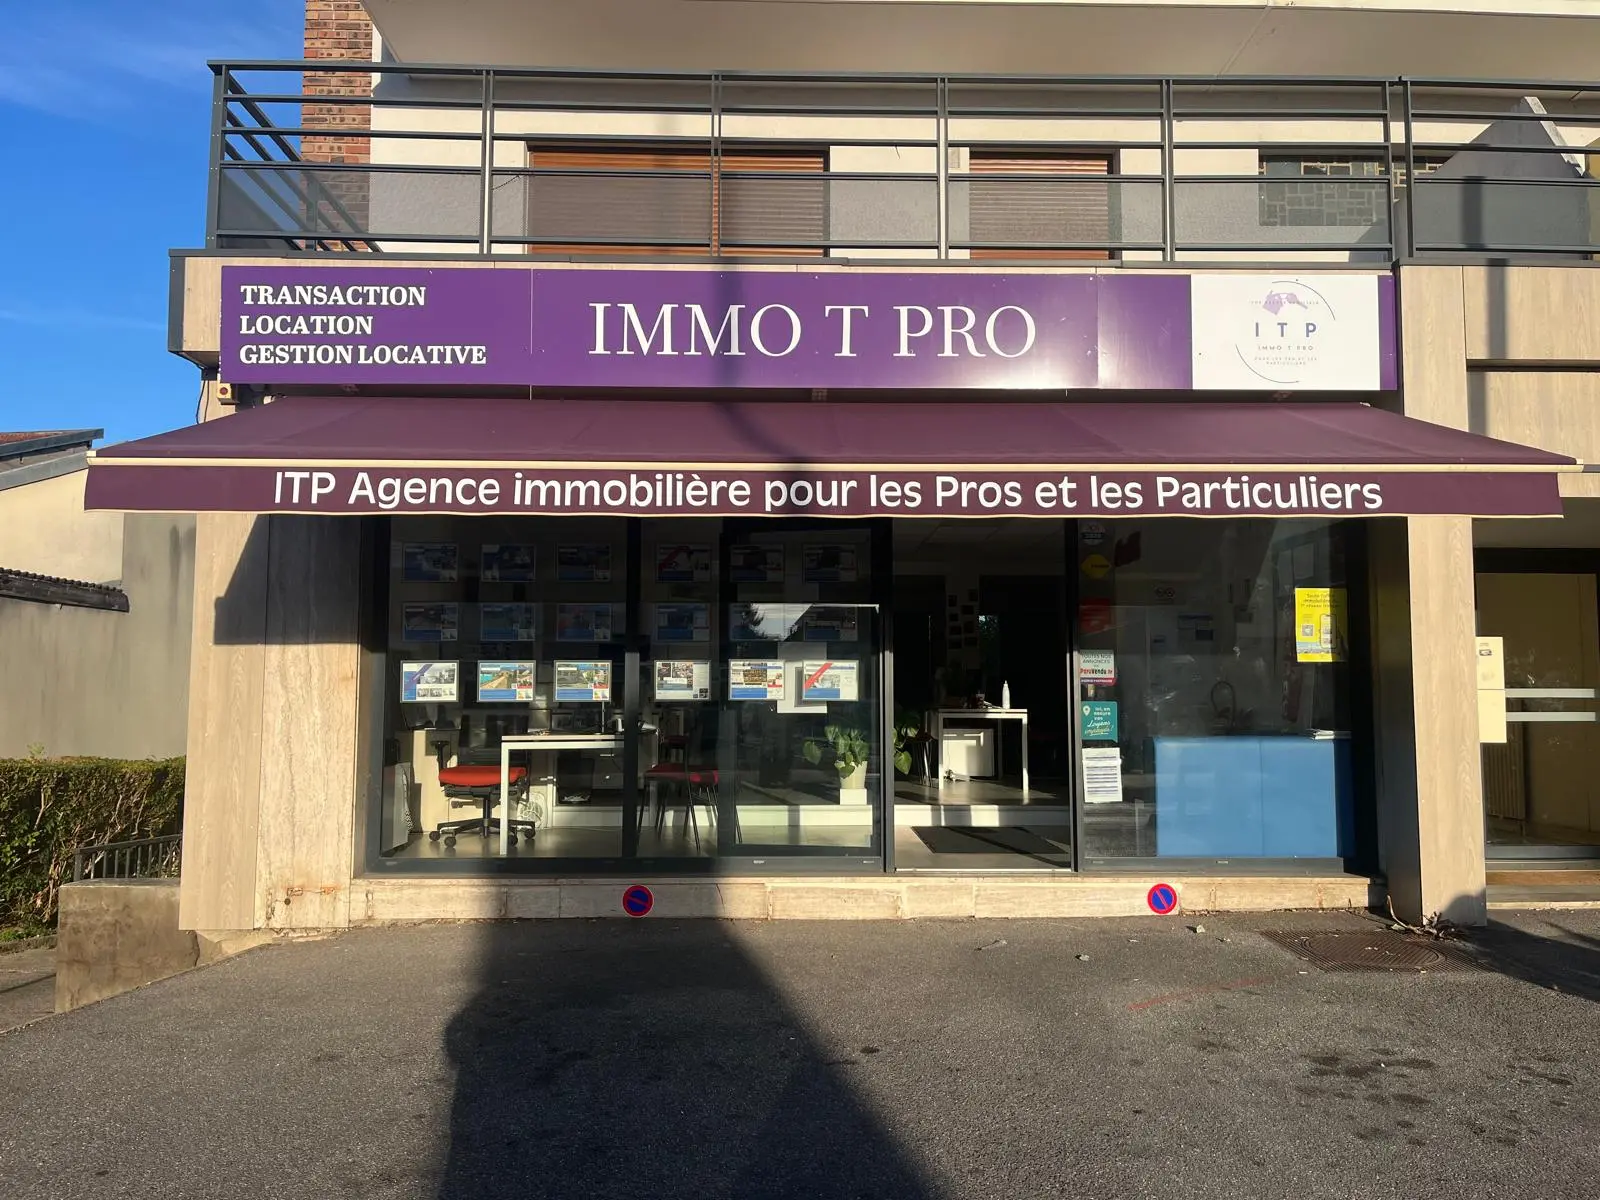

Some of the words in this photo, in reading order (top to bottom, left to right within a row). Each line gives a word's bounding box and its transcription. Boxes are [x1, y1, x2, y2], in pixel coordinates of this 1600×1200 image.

[240, 285, 427, 307] TRANSACTION
[239, 315, 374, 336] LOCATION
[588, 303, 802, 357] IMMO
[825, 304, 869, 358] T
[893, 304, 1037, 359] PRO
[239, 344, 353, 366] GESTION
[357, 344, 487, 366] LOCATIVE
[274, 471, 335, 504] ITP
[348, 472, 501, 509] Agence
[513, 472, 751, 507] immobilière
[764, 476, 858, 511] pour
[870, 475, 922, 508] les
[936, 476, 1022, 508] Pros
[1034, 478, 1077, 509] et
[1090, 475, 1143, 508] les
[1156, 476, 1383, 510] Particuliers
